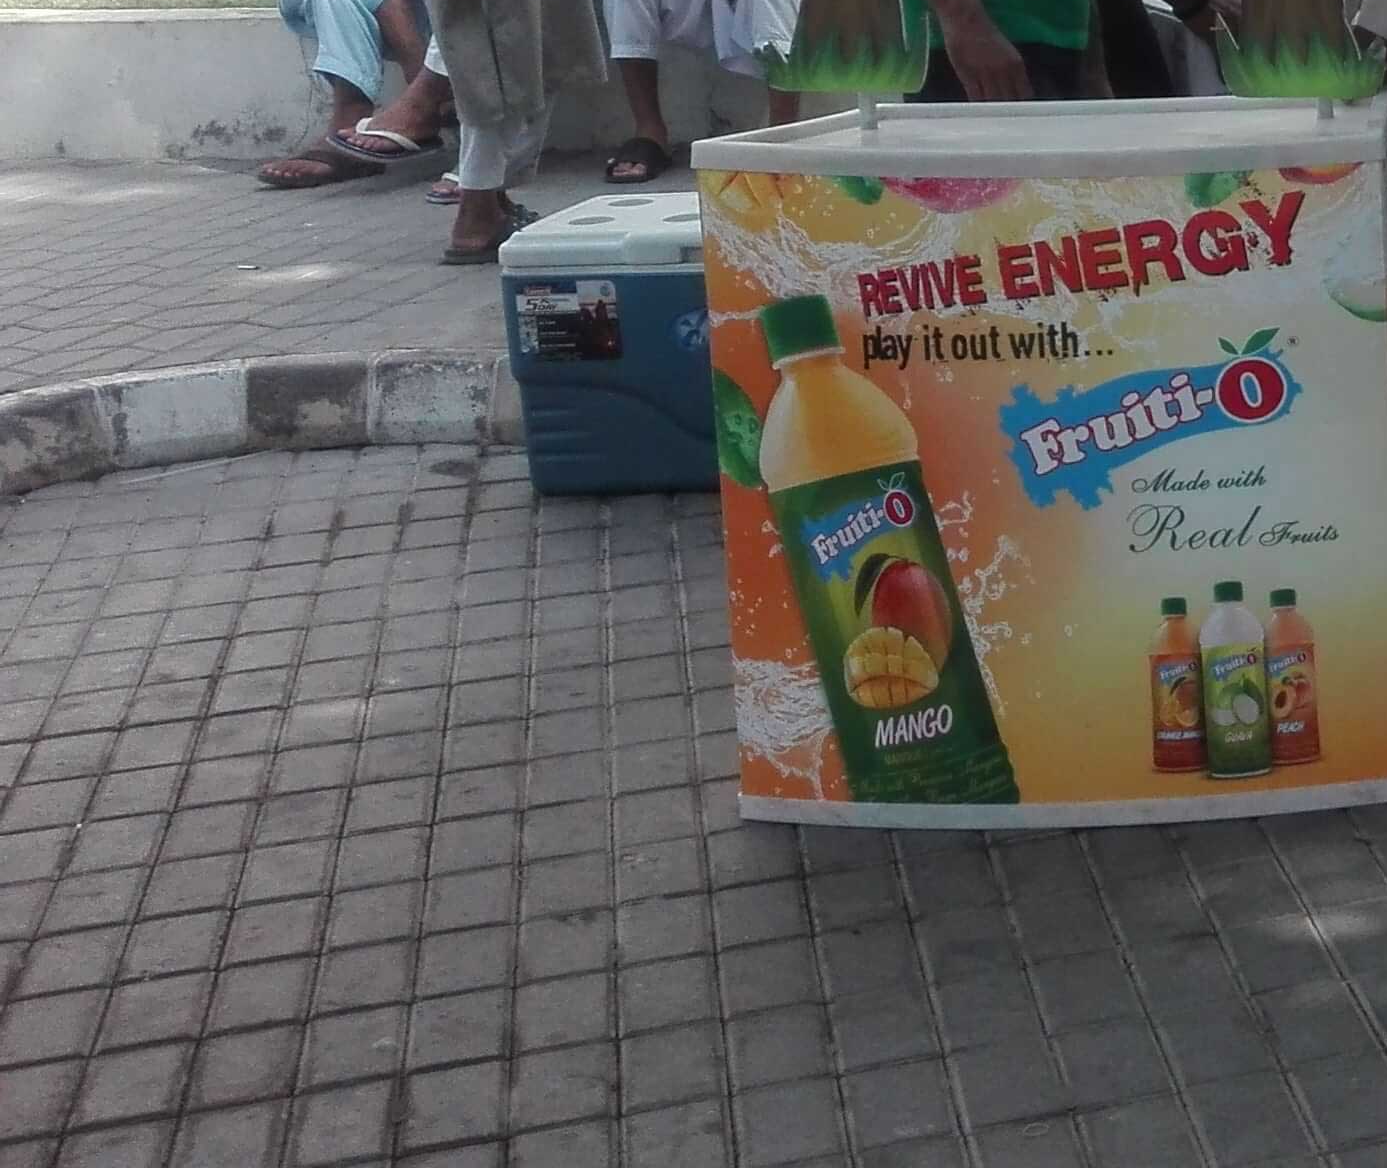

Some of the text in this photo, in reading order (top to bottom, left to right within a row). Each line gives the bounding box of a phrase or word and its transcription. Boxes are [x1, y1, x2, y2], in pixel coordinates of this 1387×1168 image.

[857, 190, 1306, 319] REVIVE ENERGY
[862, 329, 912, 369] play
[923, 327, 945, 363] it
[952, 327, 1001, 363] out
[1018, 356, 1288, 476] Fruiti-O
[1132, 465, 1267, 495] Made with
[811, 489, 916, 565] Fruiti-O
[1128, 504, 1339, 554] Real Fruits
[875, 704, 954, 748] MANGO
